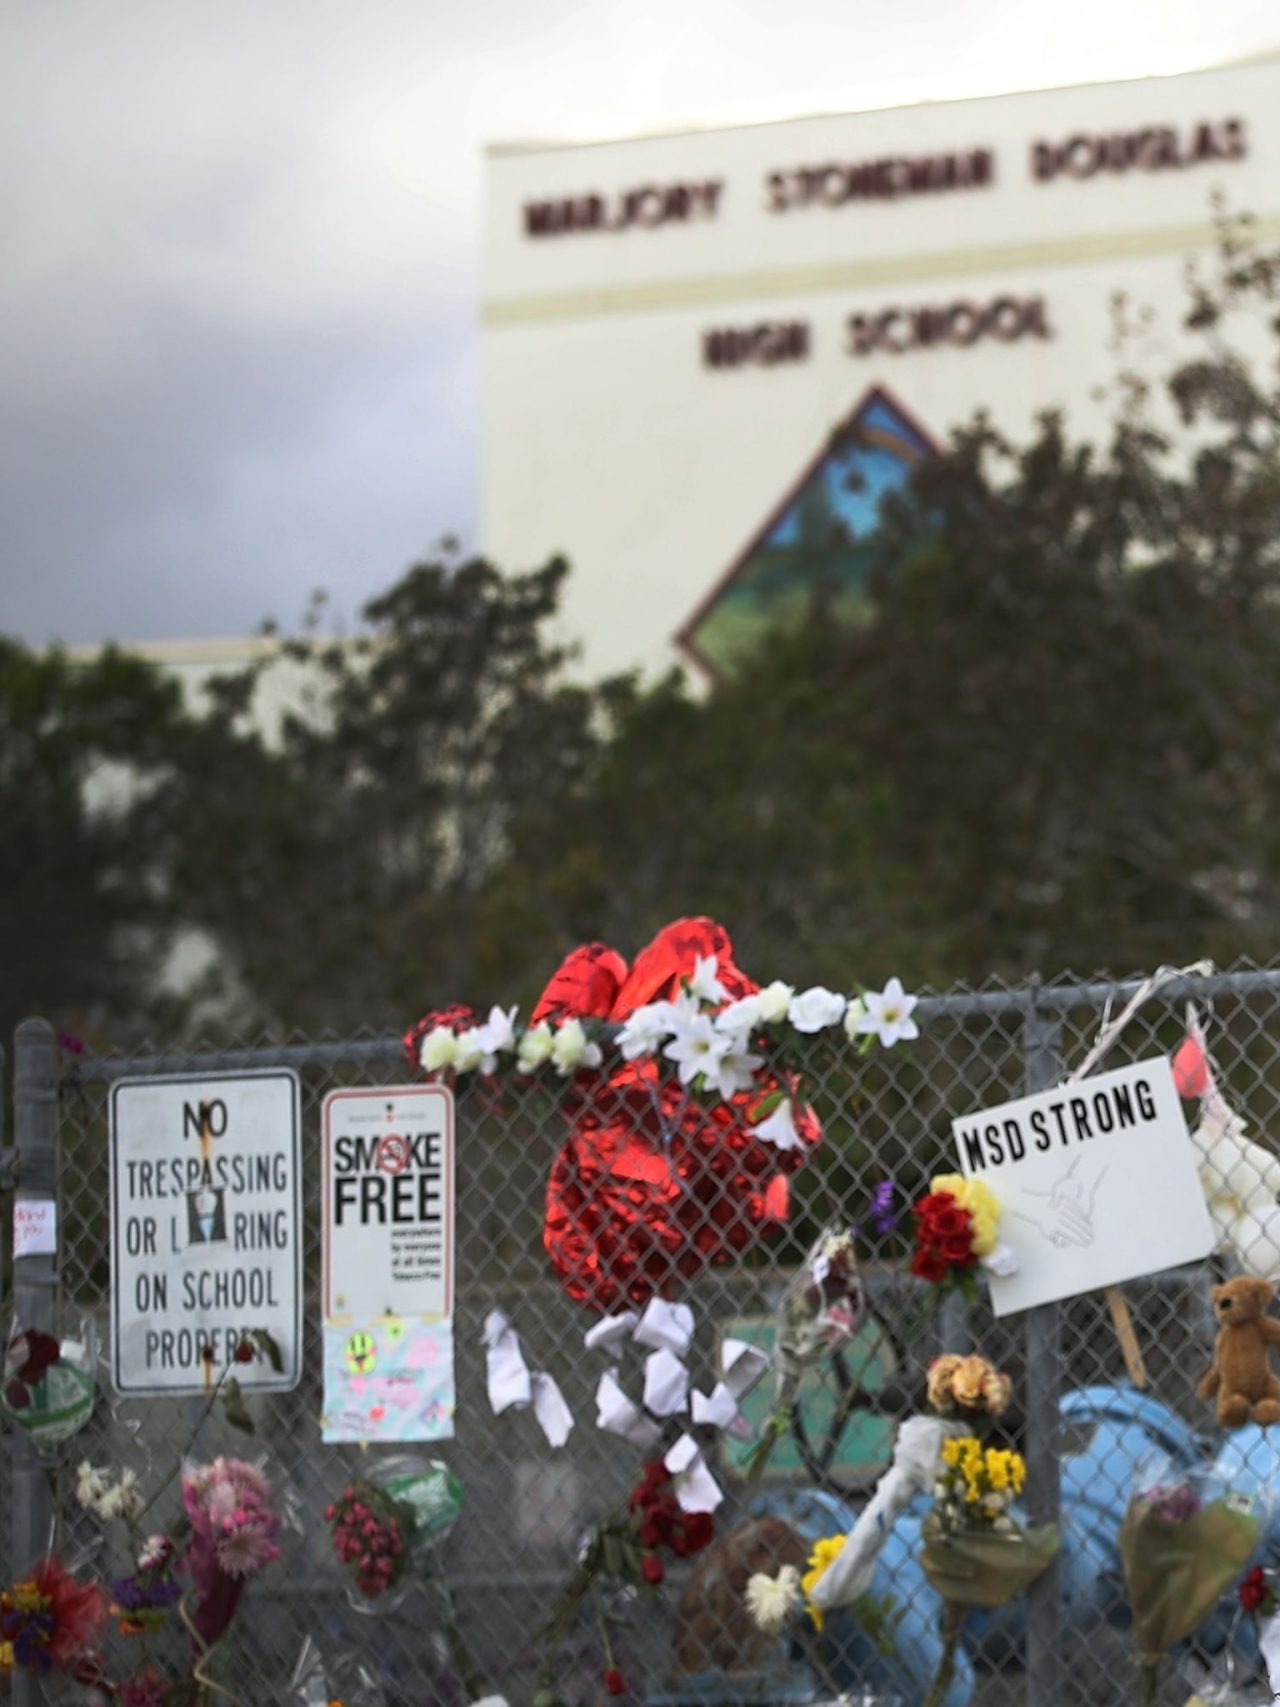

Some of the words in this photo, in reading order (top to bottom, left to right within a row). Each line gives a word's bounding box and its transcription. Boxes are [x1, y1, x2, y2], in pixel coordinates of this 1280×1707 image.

[523, 177, 725, 237] MARJORY
[764, 147, 994, 214] STONEMAN
[1030, 114, 1249, 184] DOUGLAS
[704, 319, 810, 367] HIGH
[847, 296, 1053, 355] SCHOOL
[183, 1098, 228, 1140] NO
[962, 1118, 1026, 1172] MSD
[1029, 1079, 1157, 1151] STRONG
[126, 1152, 287, 1200] TRESPASSING
[335, 1174, 441, 1225] FREE
[126, 1216, 156, 1257] OR
[171, 1209, 288, 1255] LRING
[136, 1272, 167, 1313] ON
[183, 1267, 279, 1311] SCHOOL
